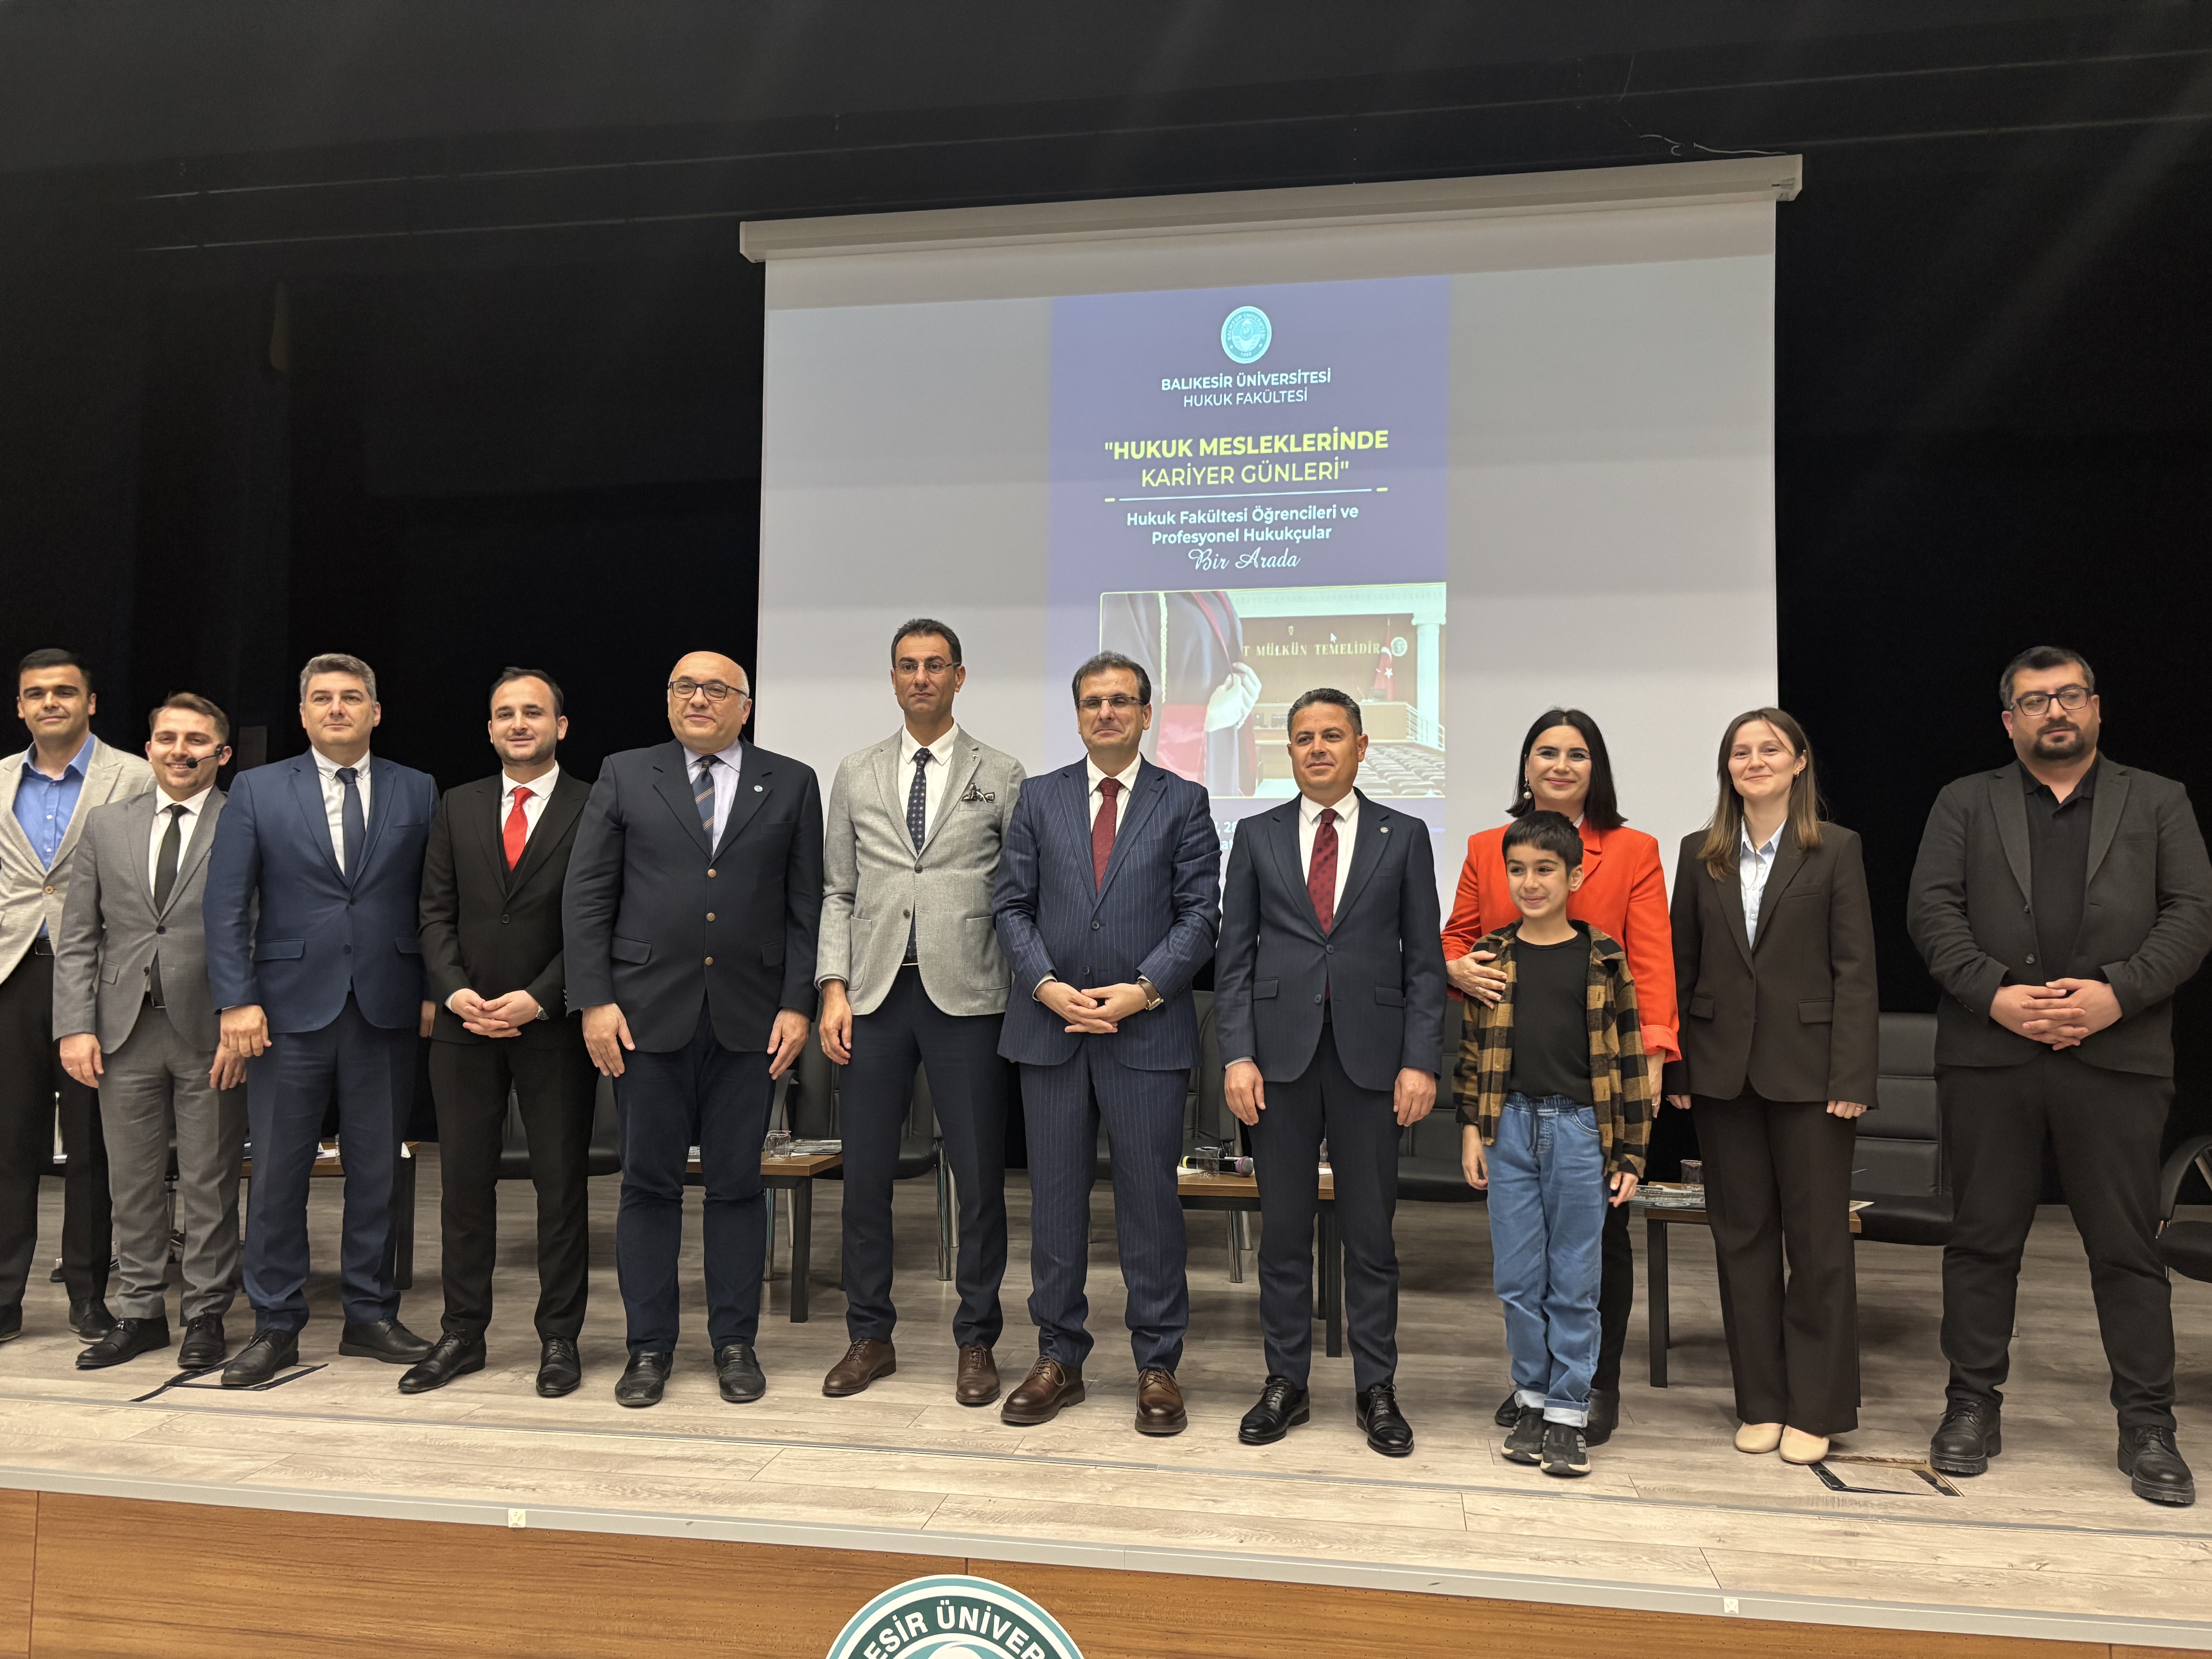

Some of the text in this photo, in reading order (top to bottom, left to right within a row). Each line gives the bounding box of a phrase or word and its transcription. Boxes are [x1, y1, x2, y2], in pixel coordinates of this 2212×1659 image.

[1162, 368, 1331, 390] BALIKESİR ÜNİVERSİTESİ
[1184, 387, 1307, 407] HUKUK FAKÜLTESİ
[1105, 426, 1389, 460] "HUKUK MESLEKLERİNDE
[1142, 457, 1349, 487] KARİYER GÜNLERİ"
[1127, 505, 1358, 526] Hukuk Fakültesi Öğrencileri ve
[1152, 526, 1333, 546] Profesyonel Hukukçular
[1188, 547, 1301, 571] Bir Arada
[1256, 642, 1307, 656] MÜLKÜN
[1315, 641, 1381, 655] TEMELİDİR
